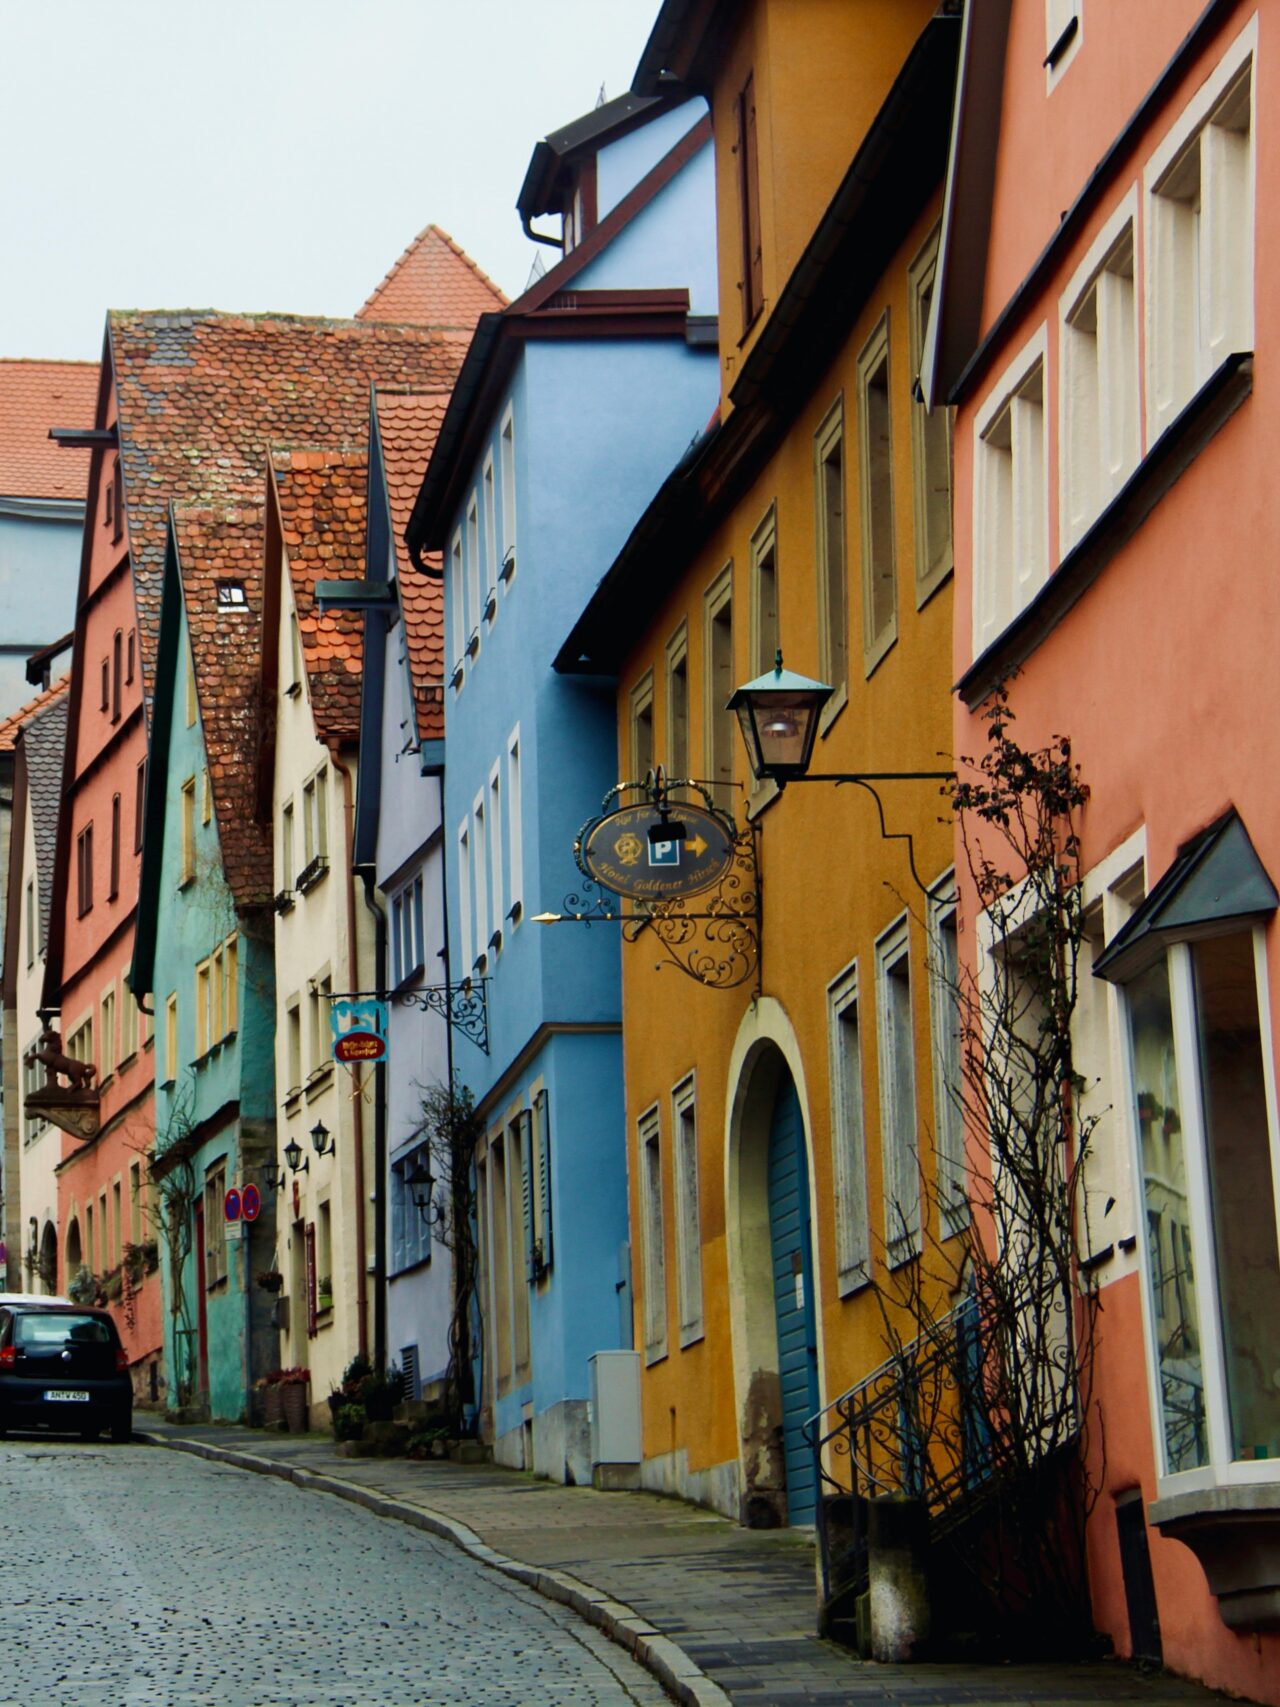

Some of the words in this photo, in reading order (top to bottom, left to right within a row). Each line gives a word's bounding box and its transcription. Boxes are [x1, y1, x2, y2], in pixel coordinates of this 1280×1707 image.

[654, 841, 672, 859] P
[599, 861, 631, 885] Hotel
[633, 879, 684, 892] Goldener
[687, 857, 721, 884] Hirsch
